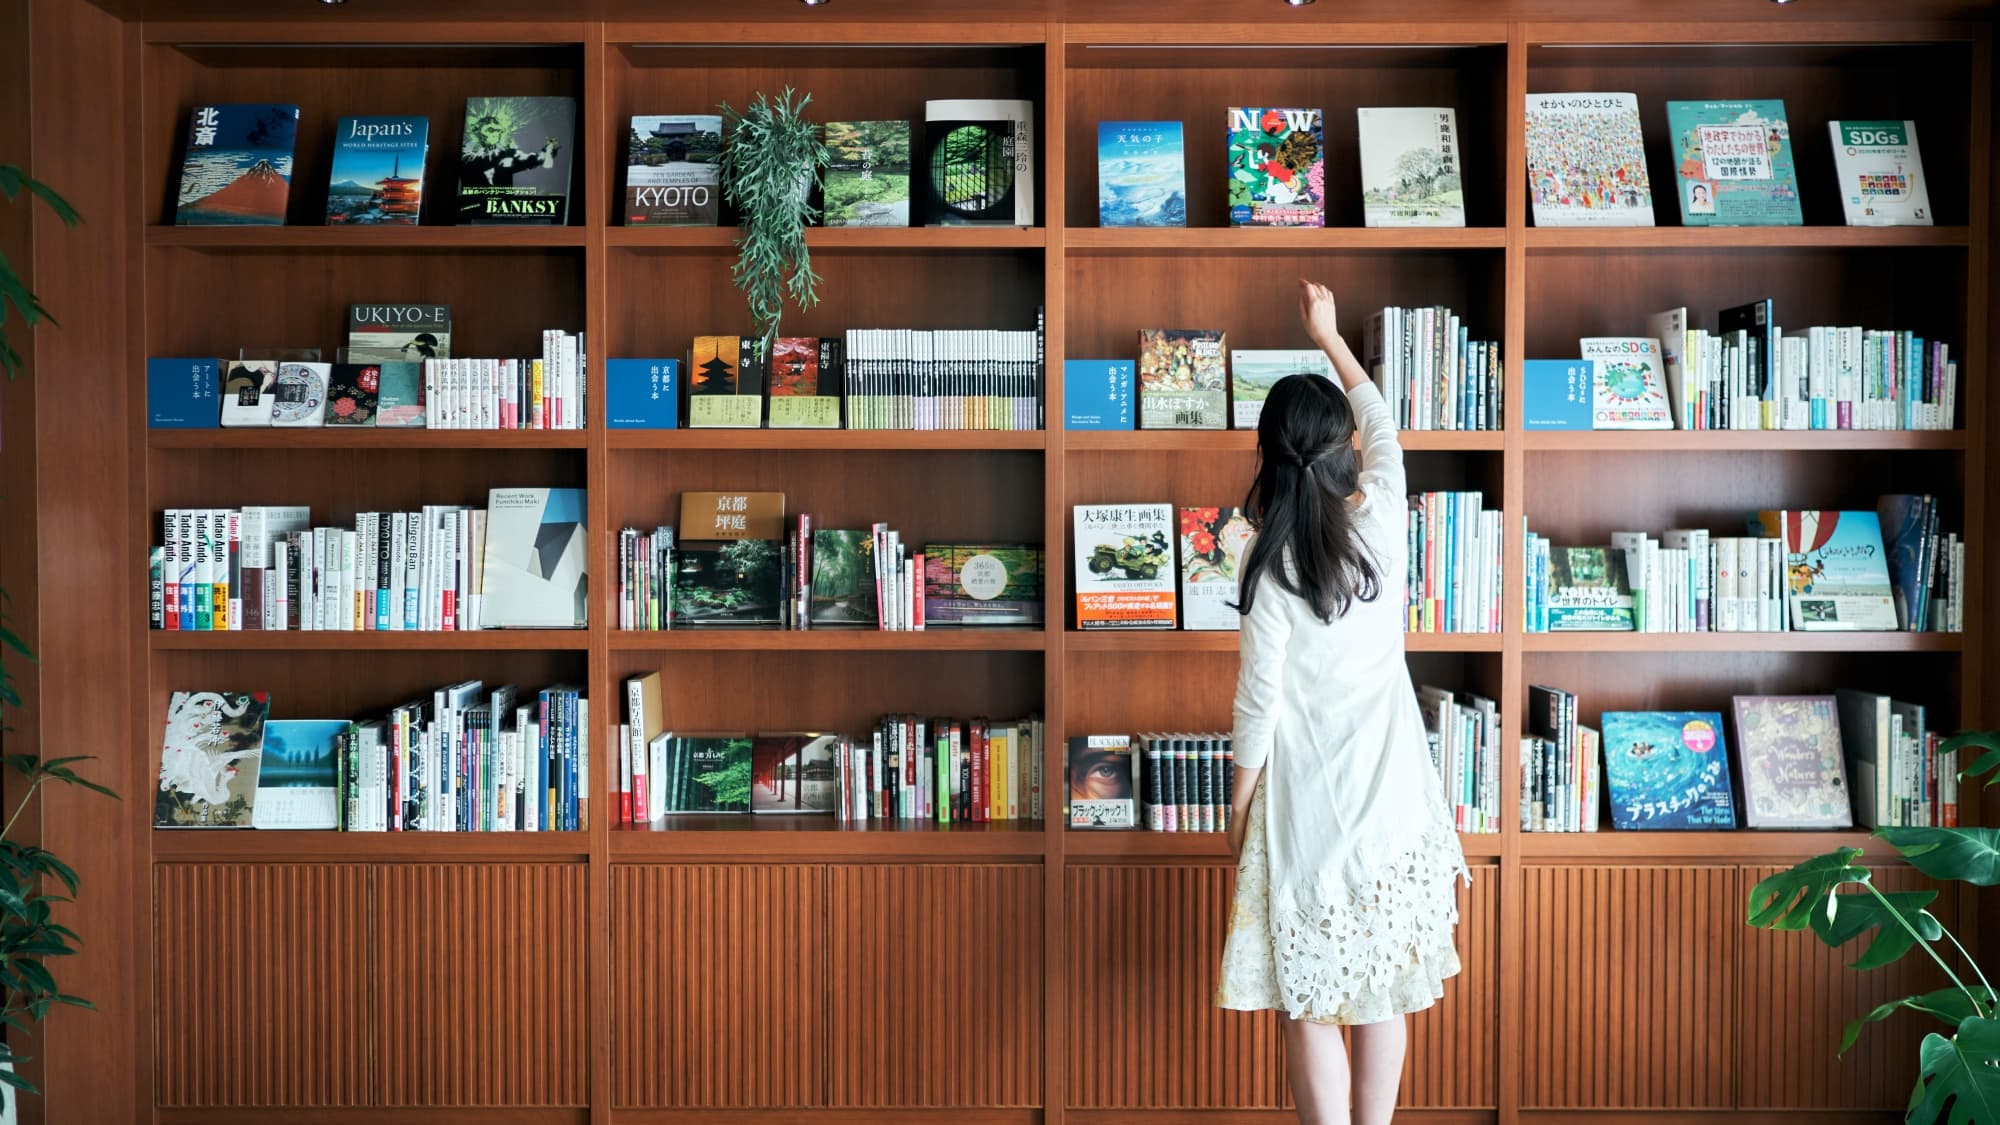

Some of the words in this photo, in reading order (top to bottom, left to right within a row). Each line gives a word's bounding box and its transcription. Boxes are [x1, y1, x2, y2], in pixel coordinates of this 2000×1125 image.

[1540, 98, 1623, 110] せかいのひとびと
[194, 107, 220, 146] 北斎
[351, 119, 413, 142] Japan's
[1704, 130, 1762, 142] 地政学でわかる
[1850, 130, 1900, 145] SDGs
[1117, 134, 1163, 144] 天気の子
[1705, 144, 1764, 156] わたしたちの世界
[1711, 157, 1762, 166] 12の地図が語る
[1720, 166, 1757, 177] 国際情勢
[486, 200, 560, 214] BANKSY
[635, 186, 709, 207] KYOTO
[192, 365, 201, 399] 出会う本
[203, 365, 211, 398] アートに
[651, 365, 659, 401] 出会う本
[662, 366, 671, 392] 京都に
[1108, 366, 1117, 401] 出会う本
[1567, 367, 1576, 401] 出会う本
[1579, 366, 1587, 405] SDGsに
[1120, 366, 1128, 424] マンガ・アニメに
[1175, 410, 1203, 425] 画集
[716, 495, 747, 512] 京都
[1083, 508, 1166, 522] 大塚康生画集
[164, 513, 176, 539] Tadao
[180, 513, 192, 539] Tadao
[196, 514, 208, 540] Tadao
[214, 513, 226, 539] Tadao
[409, 515, 420, 551] Shigeru
[715, 514, 746, 530] 坪庭
[164, 540, 176, 563] Ando
[180, 540, 192, 563] Ando
[196, 541, 208, 564] Ando
[214, 540, 226, 563] Ando
[409, 552, 418, 571] Ban
[1561, 595, 1618, 606] 世界のトイレ
[1626, 760, 1721, 822] プラスチックのうみ
